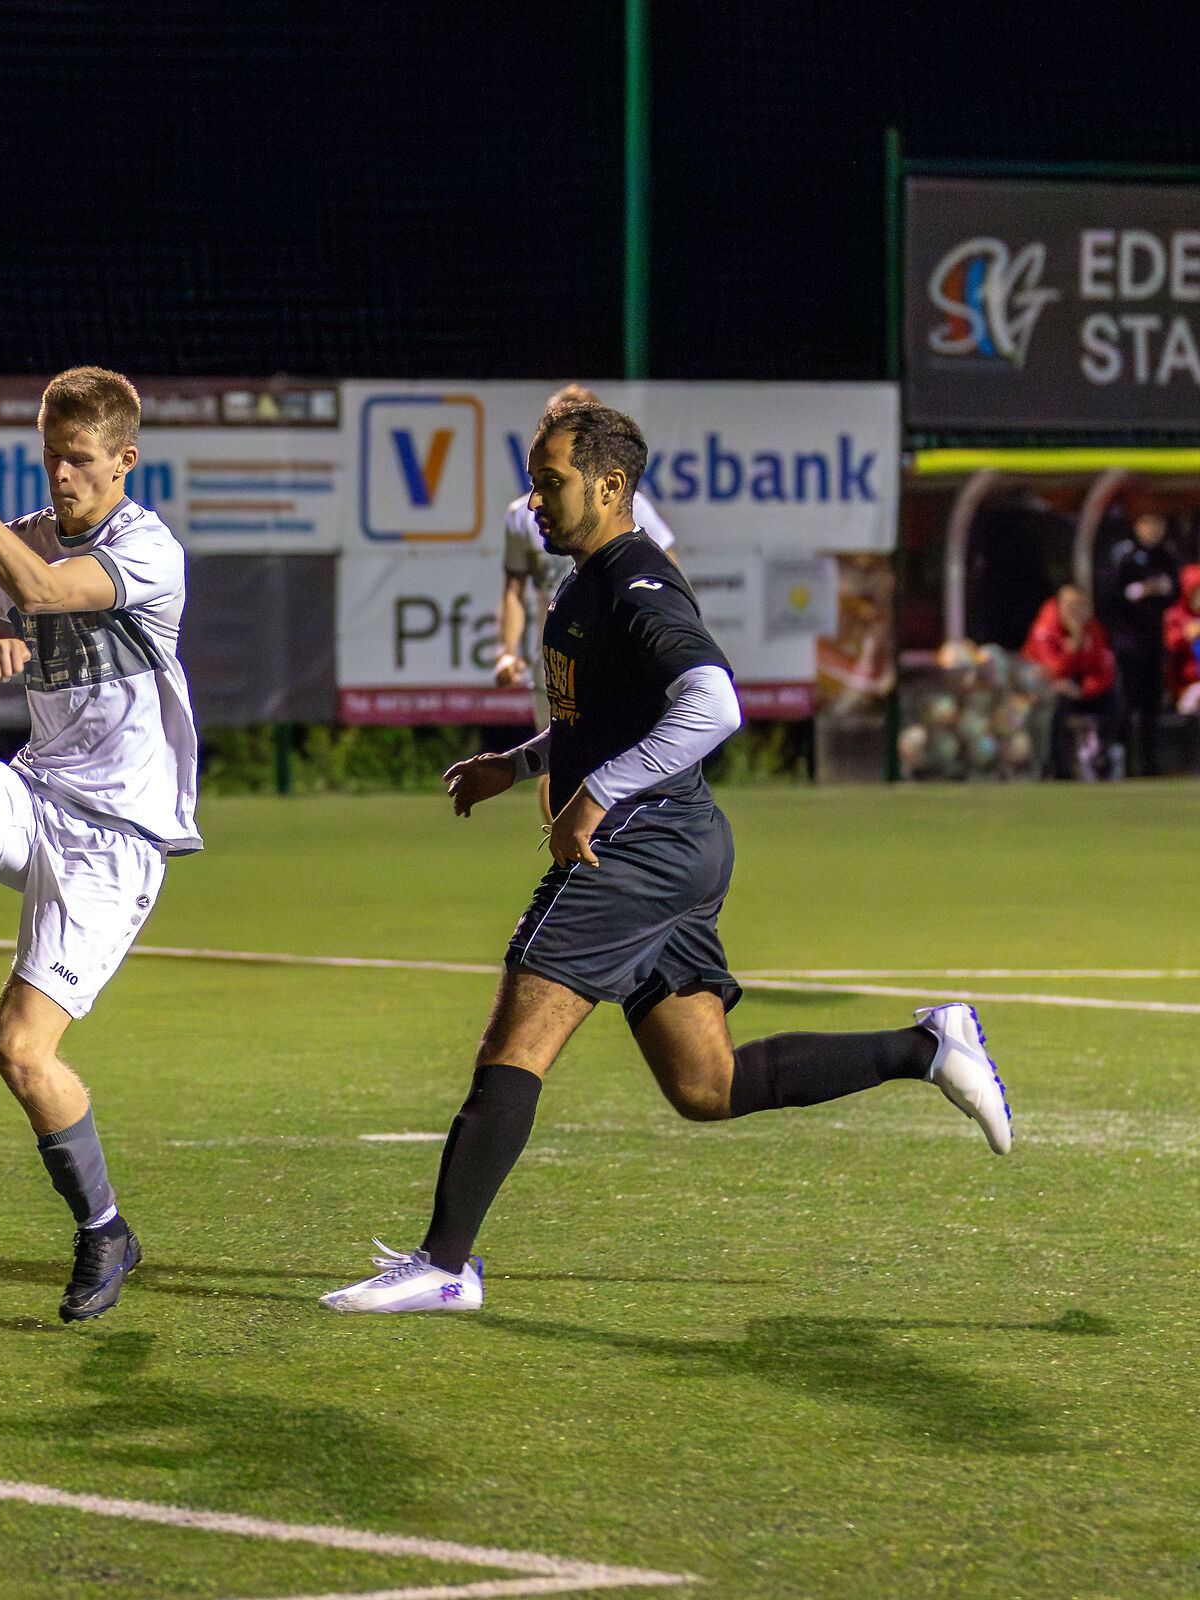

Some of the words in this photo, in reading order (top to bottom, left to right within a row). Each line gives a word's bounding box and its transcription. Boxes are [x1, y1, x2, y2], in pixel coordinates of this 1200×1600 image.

[1081, 230, 1200, 300] EDE
[1081, 314, 1200, 386] STA
[48, 961, 79, 986] JAKO
